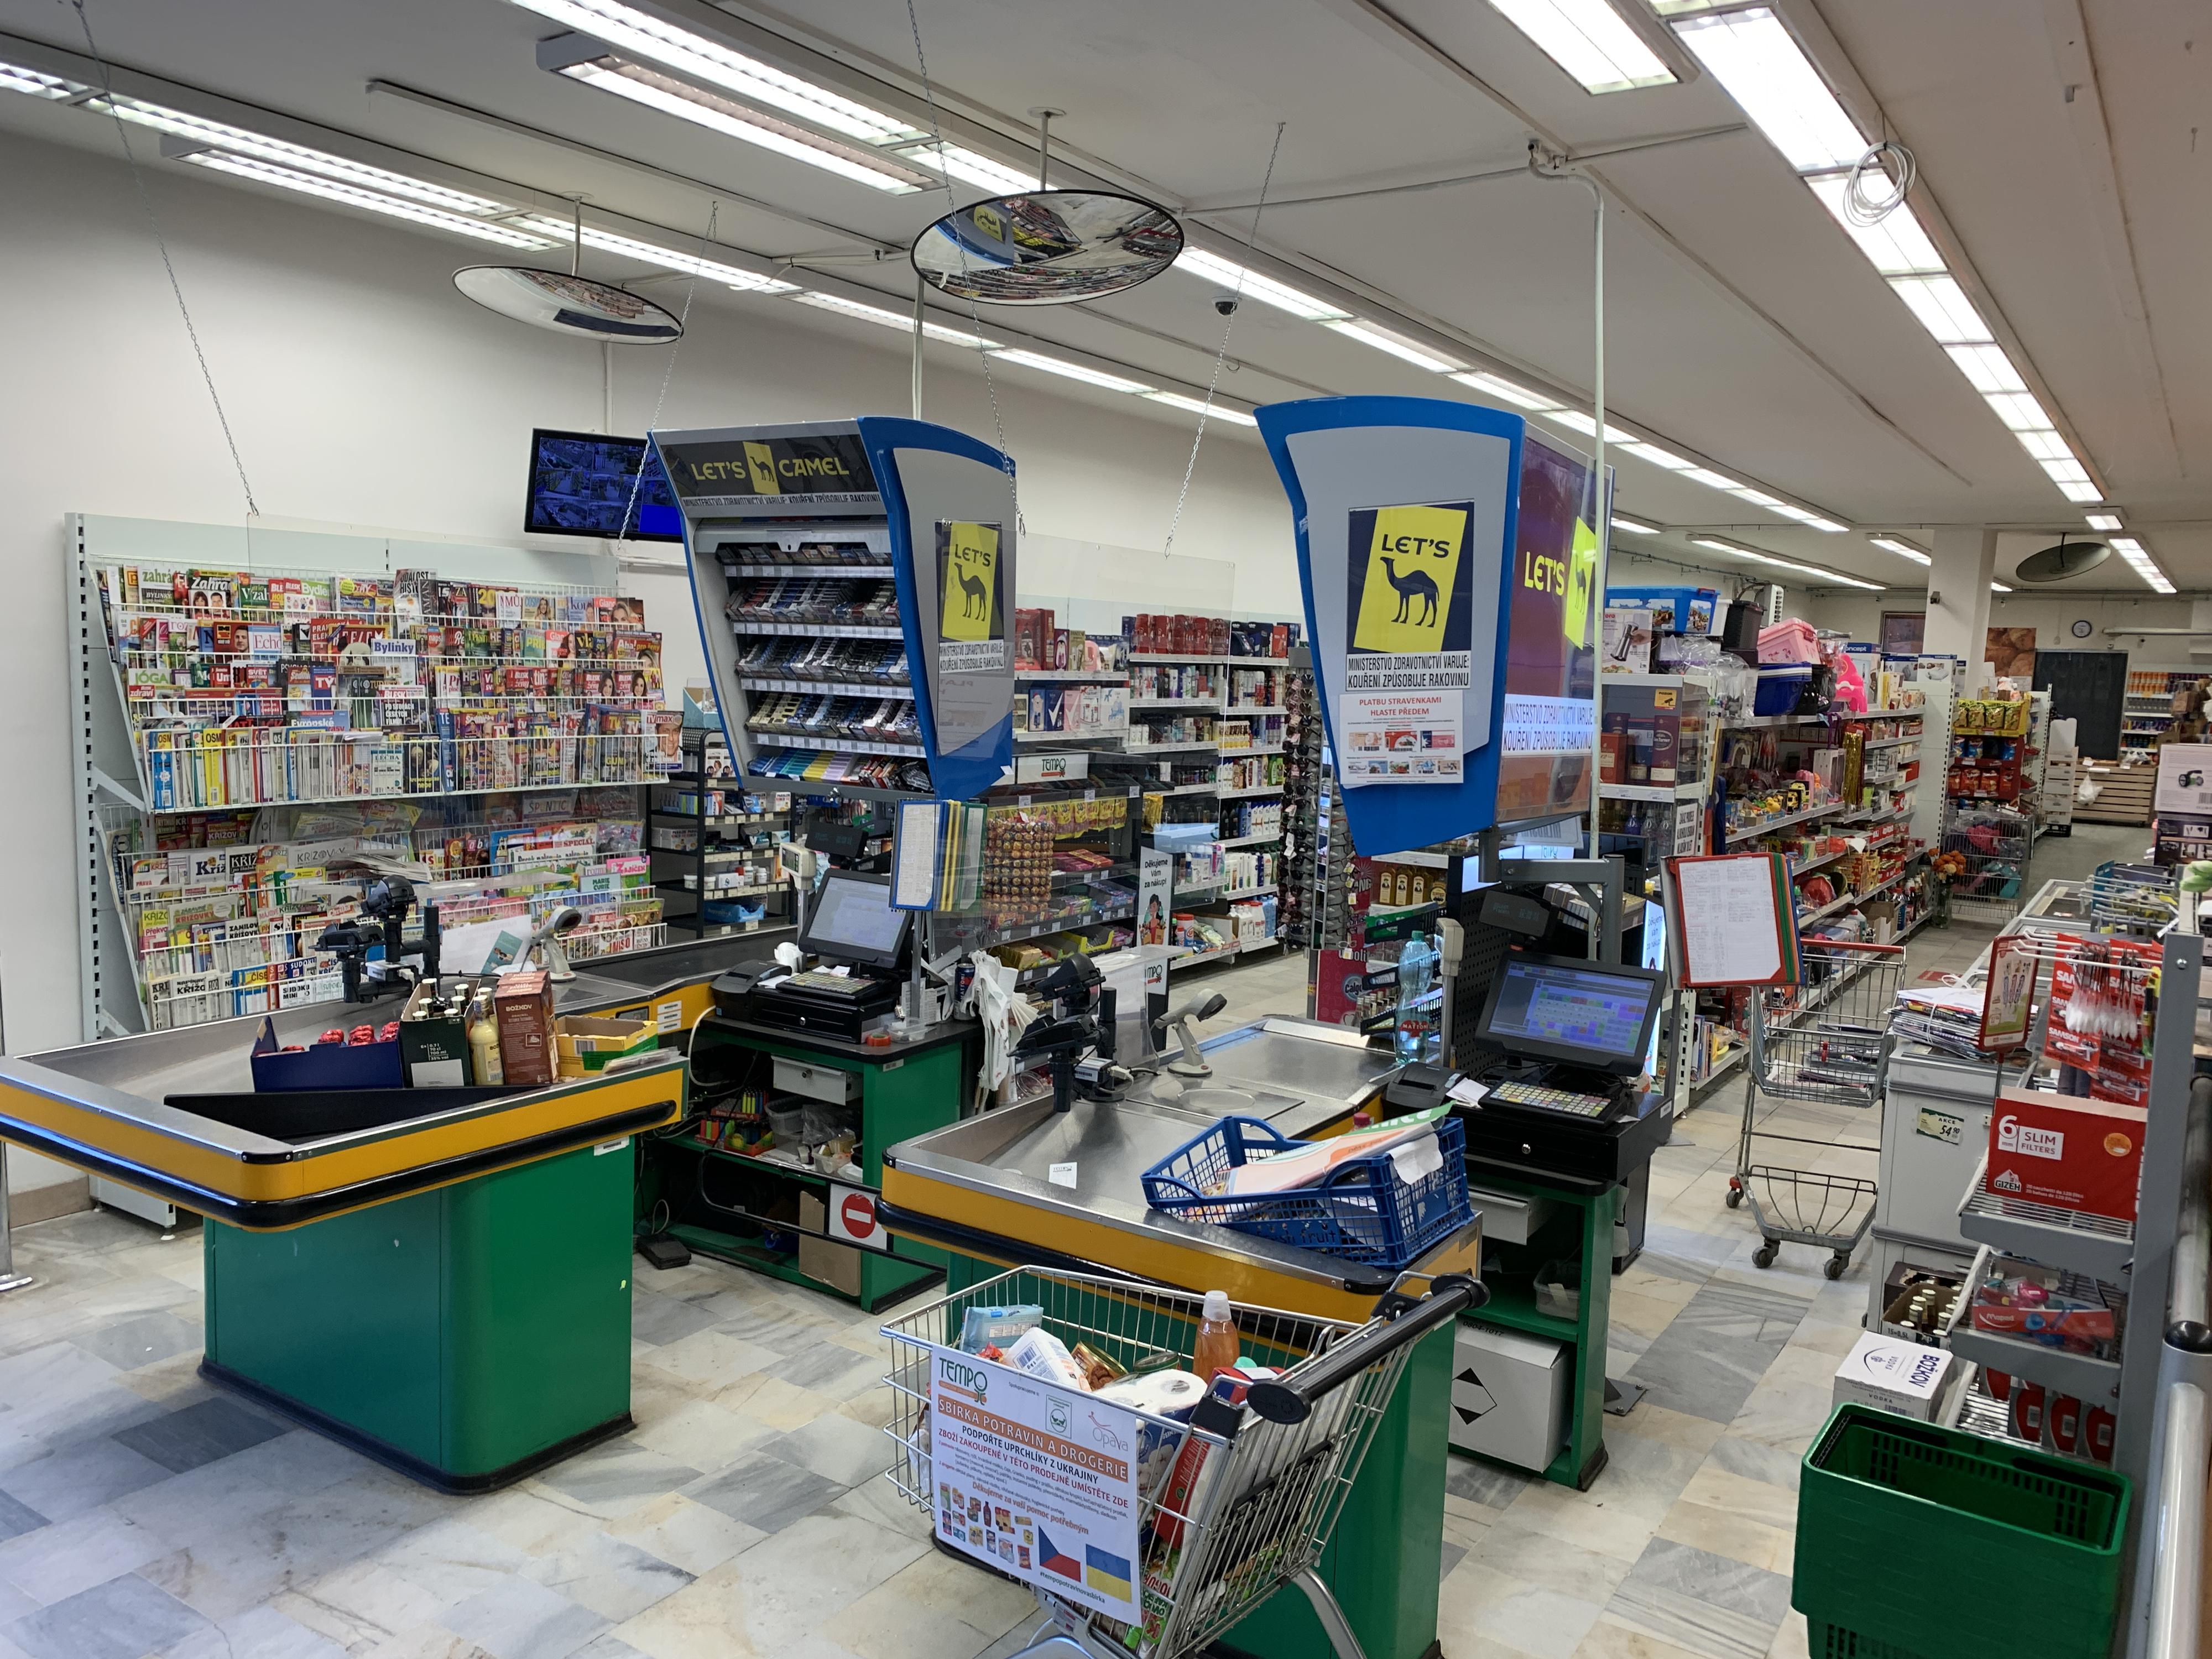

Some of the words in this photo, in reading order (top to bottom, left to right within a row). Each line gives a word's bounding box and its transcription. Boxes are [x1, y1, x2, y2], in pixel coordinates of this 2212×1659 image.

[691, 461, 746, 480] LET'S
[779, 457, 849, 477] CAMEL
[954, 544, 991, 567] LET'S
[1381, 534, 1450, 559] LET'S
[1524, 551, 1565, 596] LET'S
[374, 641, 414, 654] Bylinky
[940, 658, 958, 671] KOUŘENÍ
[1348, 657, 1392, 671] MINISTERSTVO
[1394, 653, 1442, 670] ZDRAVOTNICTVÍ
[1443, 654, 1469, 669] VARUJE:
[1348, 671, 1381, 688] KOUŘENÍ
[1383, 671, 1426, 687] ZPŮSOBUJE
[1428, 672, 1469, 687] RAKOVINU
[1388, 696, 1442, 705] STRAVENKAMI
[1399, 707, 1430, 716] PŘEDEM
[1503, 726, 1532, 751] KOUŘENÍ
[1041, 758, 1066, 771] TEMPO
[564, 838, 594, 847] SPECIAL
[1144, 858, 1168, 869] Děkujeme
[505, 1004, 533, 1012] BOŽKOV
[2048, 1026, 2079, 1043] SAMSON
[1939, 1125, 1952, 1137] 54
[1998, 1114, 2018, 1139] 6
[2024, 1132, 2056, 1145] SLIM
[2021, 1142, 2056, 1155] FILTERS
[1995, 1179, 2021, 1191] GIZEH
[938, 1357, 988, 1392] TEMPO
[1908, 1354, 1940, 1388] BOŽKOV
[1868, 1393, 1893, 1404] VODKA
[938, 1399, 979, 1425] SBÍRKA
[983, 1415, 1044, 1448] POTRAVIN
[1048, 1439, 1056, 1453] A
[1060, 1444, 1127, 1480] DROGERIE
[1092, 1427, 1129, 1452] Opava
[962, 1425, 1003, 1448] PODPOŘTE
[1004, 1441, 1048, 1465] UPRCHLÍKY
[1050, 1458, 1055, 1468] Z
[1057, 1462, 1098, 1484] UKRAJINY
[938, 1428, 958, 1443] ZBOŽÍ
[959, 1436, 1001, 1460] ZAKOUPENÉ
[1003, 1453, 1008, 1462] V
[1009, 1454, 1029, 1470] TÉTO
[1030, 1464, 1070, 1486] PRODEJNĚ
[1071, 1480, 1110, 1502] UMÍSTĚTE
[1113, 1495, 1129, 1508] ZDE
[972, 1481, 1003, 1501] Děkujeme
[1026, 1504, 1049, 1519] pomoc
[1050, 1514, 1089, 1535] potřebným
[1040, 1570, 1105, 1604] #tempopotravinovasbirka
